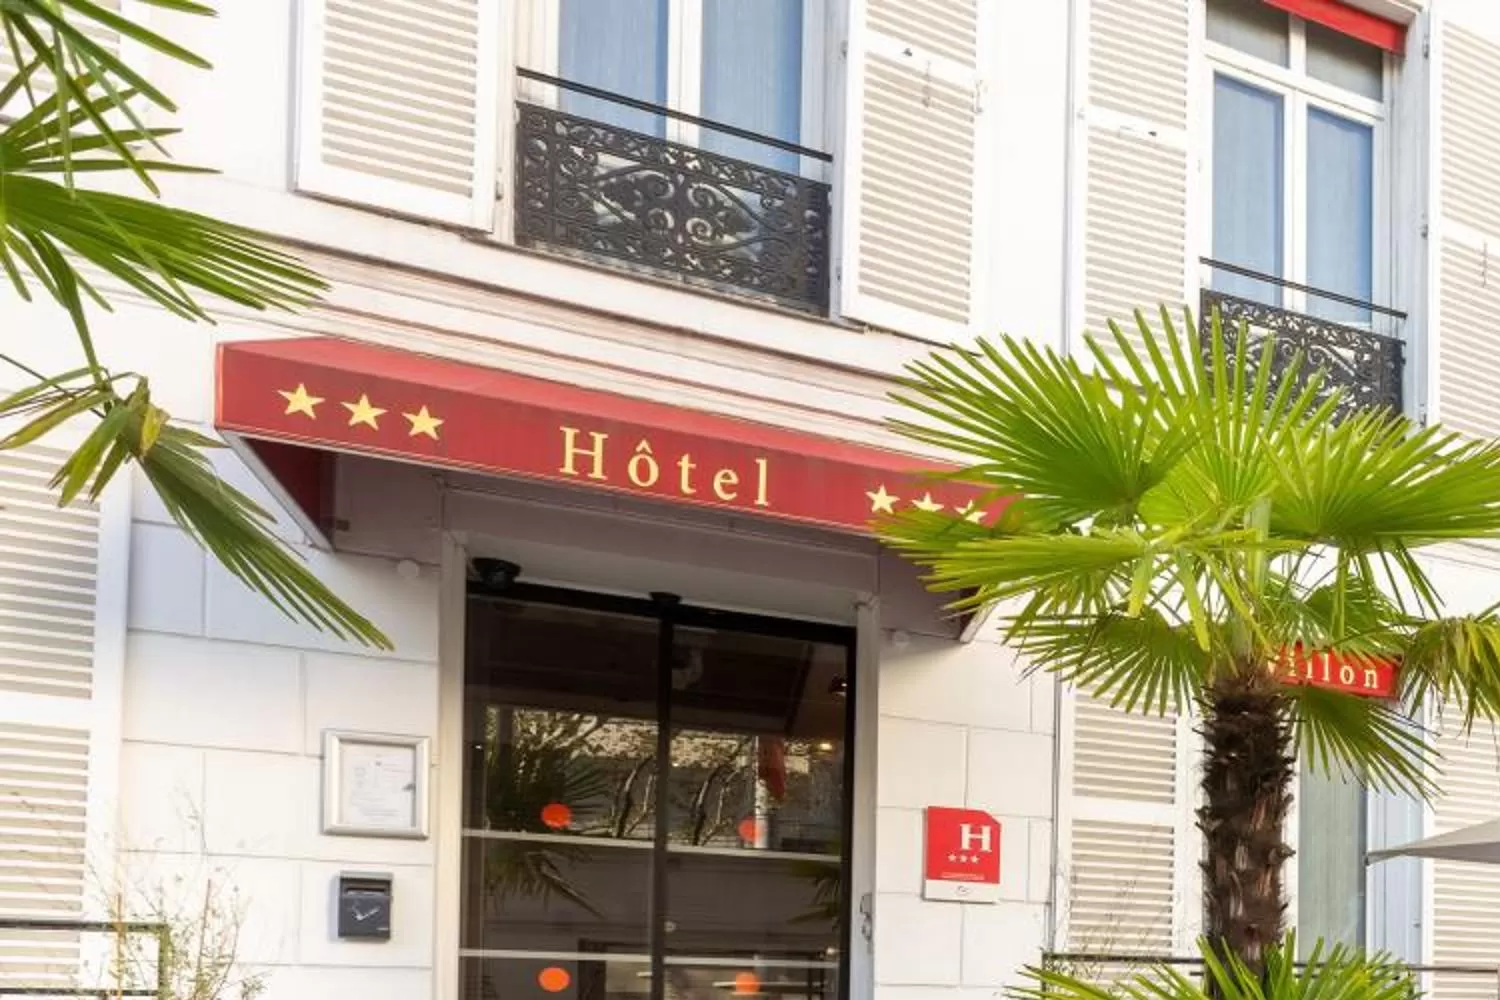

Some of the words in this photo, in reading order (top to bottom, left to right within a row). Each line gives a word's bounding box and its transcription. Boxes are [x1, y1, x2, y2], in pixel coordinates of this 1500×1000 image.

[559, 425, 769, 506] Hôtel
[1267, 651, 1379, 689] villon
[960, 823, 992, 852] H
